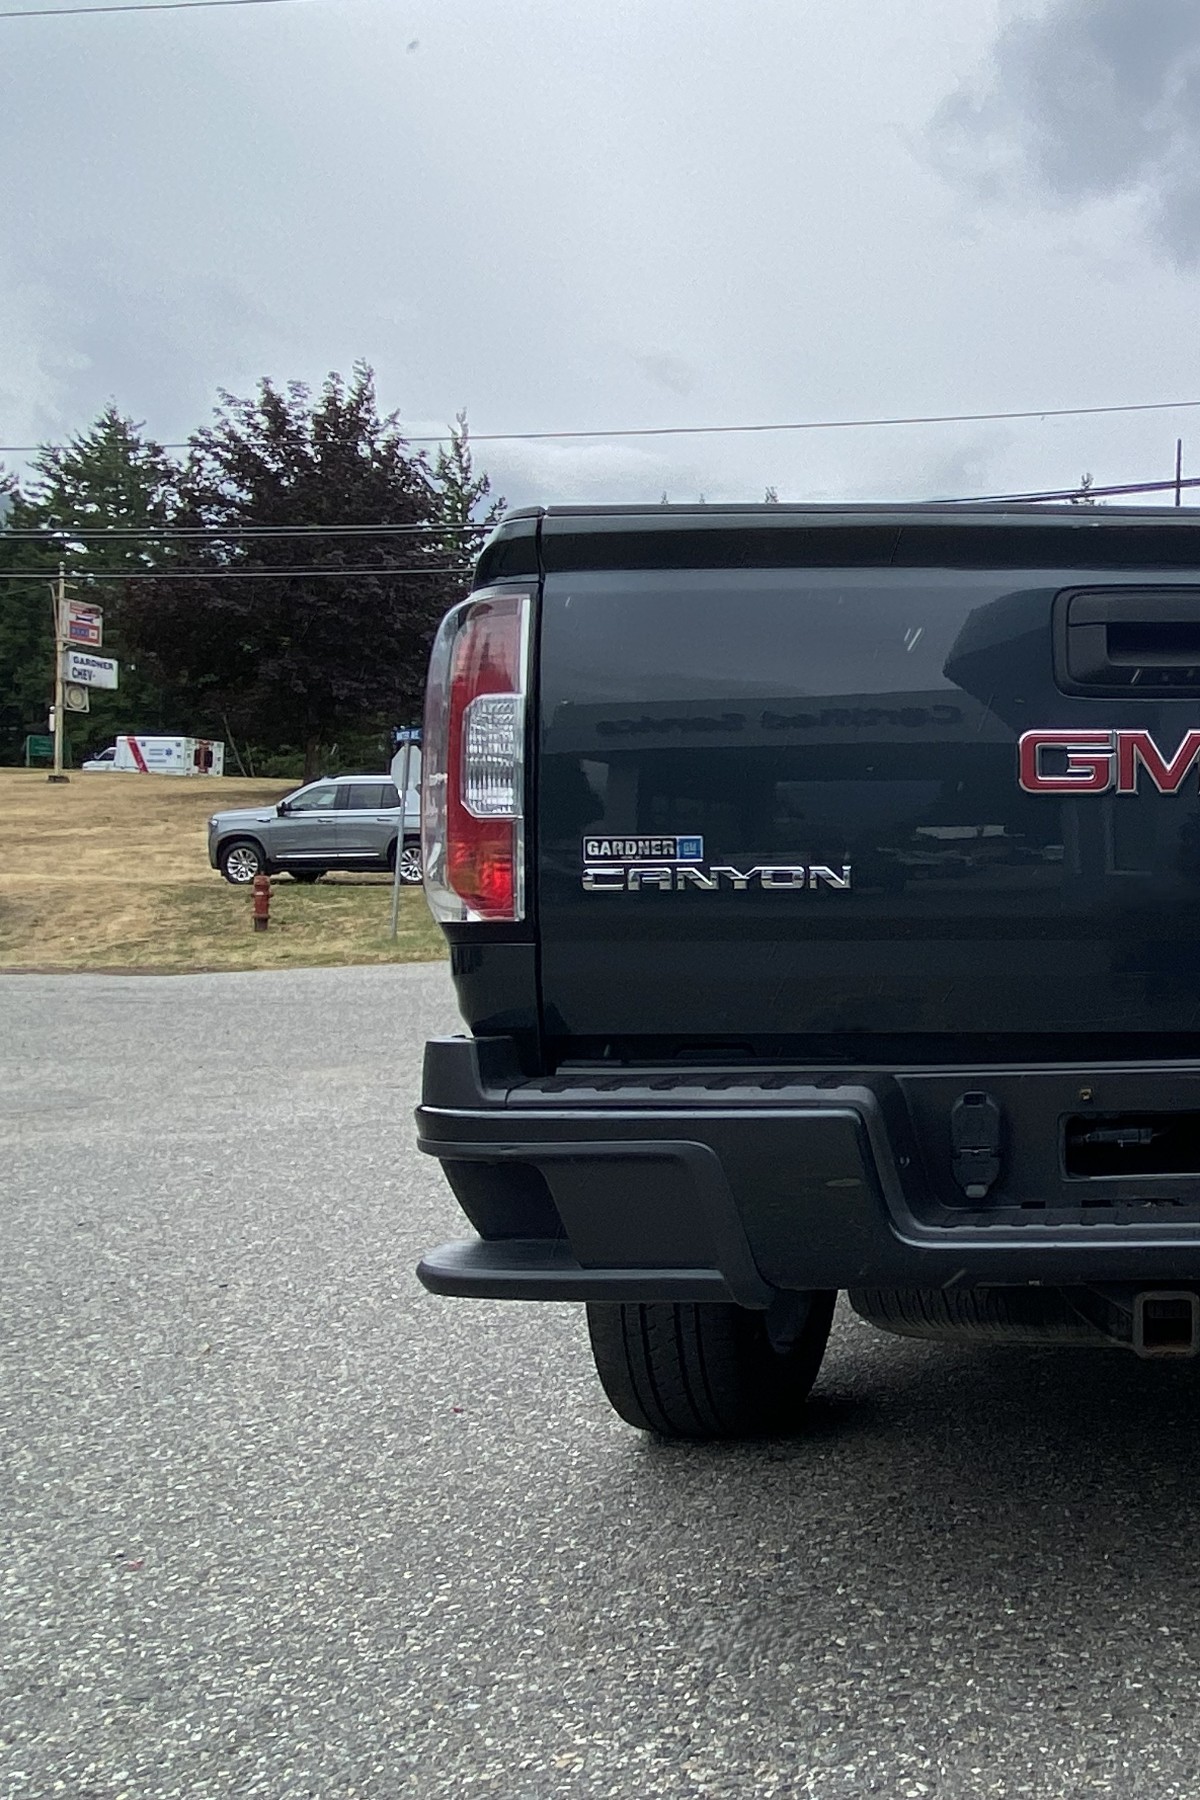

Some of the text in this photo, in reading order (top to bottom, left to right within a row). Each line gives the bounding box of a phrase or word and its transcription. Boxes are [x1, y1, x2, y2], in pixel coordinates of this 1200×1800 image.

[73, 655, 114, 671] GARDNER
[586, 840, 696, 856] GARDNER GM
[582, 865, 852, 891] CANYON
